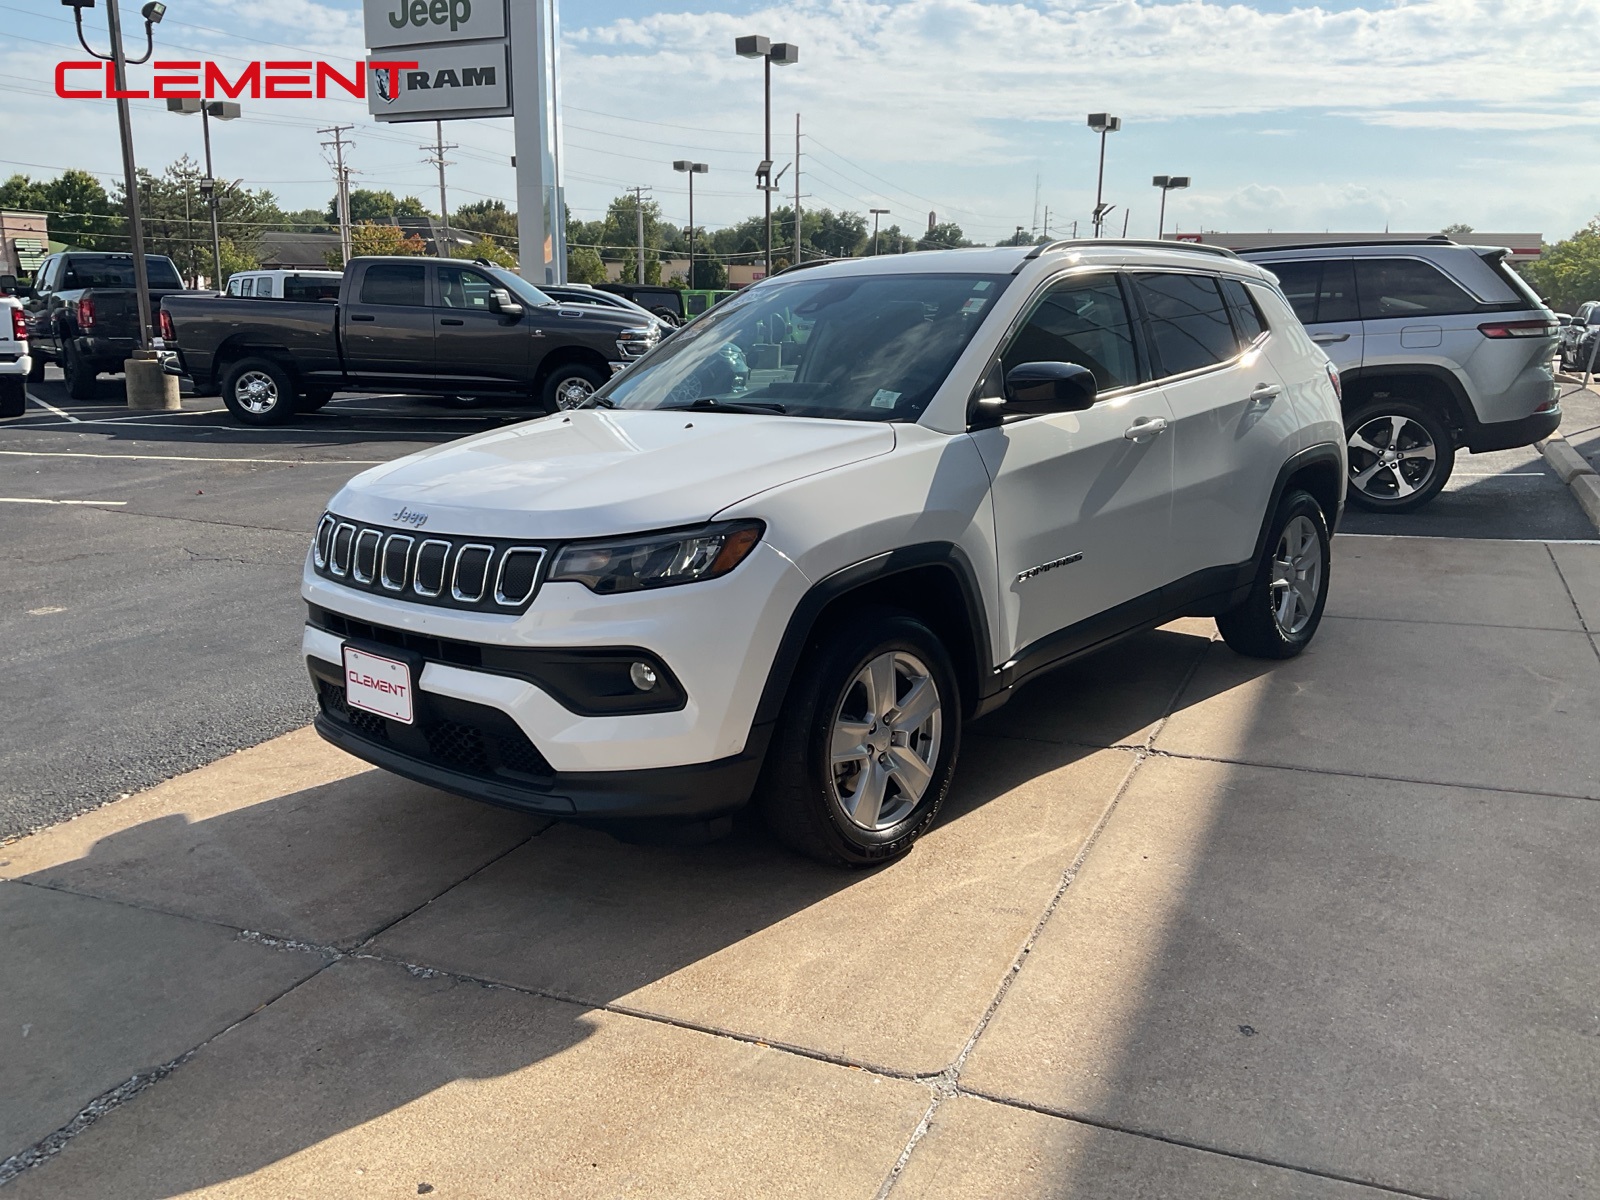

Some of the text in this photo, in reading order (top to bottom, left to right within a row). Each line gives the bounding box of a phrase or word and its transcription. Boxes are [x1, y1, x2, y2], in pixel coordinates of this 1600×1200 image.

[388, 0, 471, 31] Jeep
[407, 67, 496, 90] RAM
[392, 506, 428, 528] Jeep
[1016, 551, 1083, 582] COMPASS
[348, 670, 406, 697] CLEMENT
